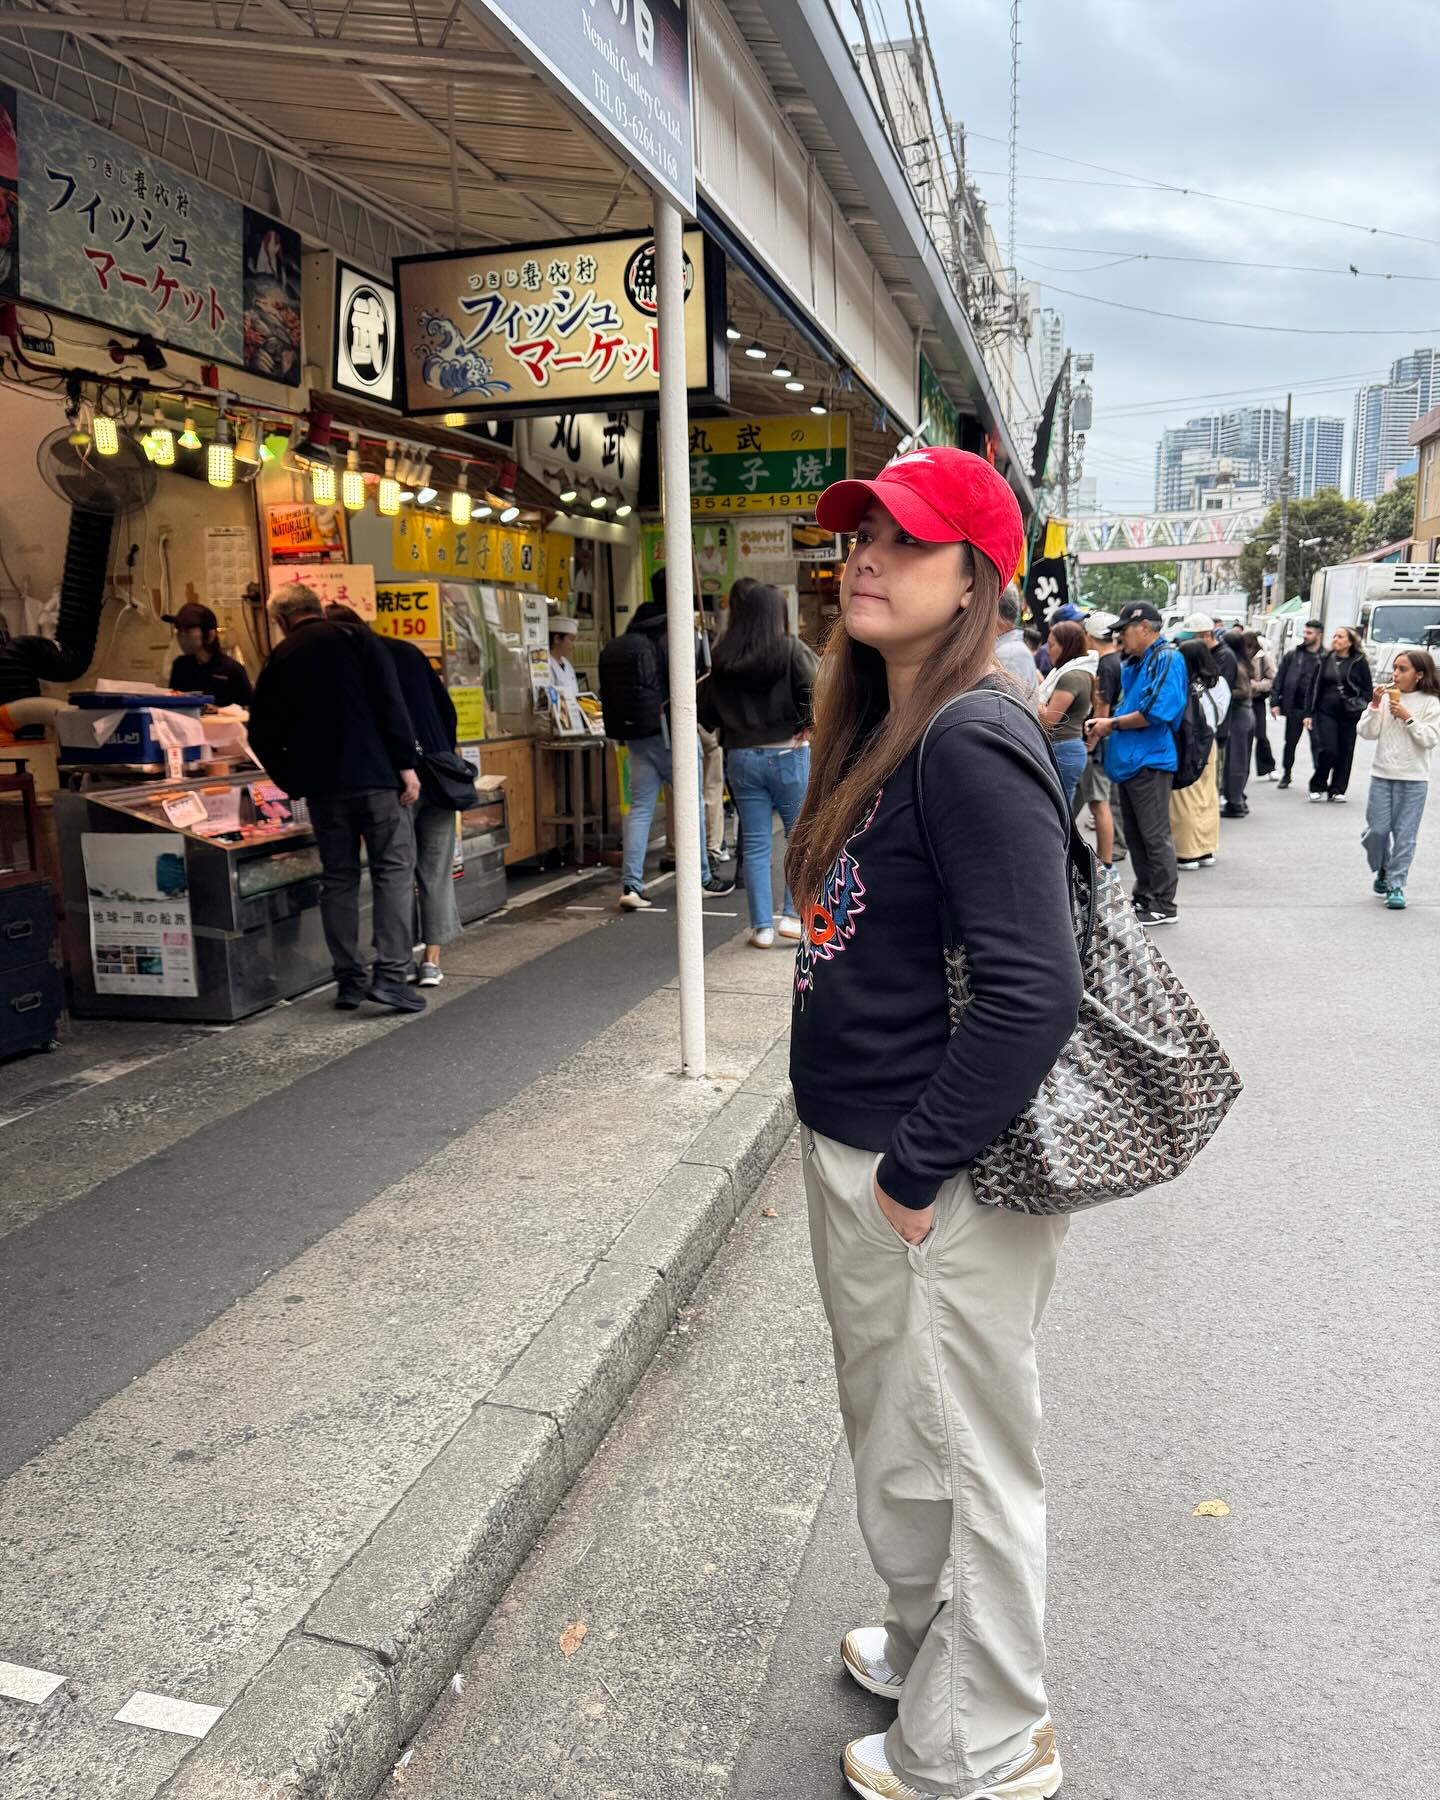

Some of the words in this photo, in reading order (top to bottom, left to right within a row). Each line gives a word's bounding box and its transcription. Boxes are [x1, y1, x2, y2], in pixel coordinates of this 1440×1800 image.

[582, 8, 619, 74] Nenohi
[620, 56, 655, 120] Cutlery
[592, 68, 613, 115] TEL
[615, 96, 678, 180] 03-6264-1168
[45, 166, 192, 267] フィッシュ
[83, 247, 225, 331] マーケット
[461, 289, 620, 344] フィッシュ
[470, 256, 596, 288] つきじ喜代村
